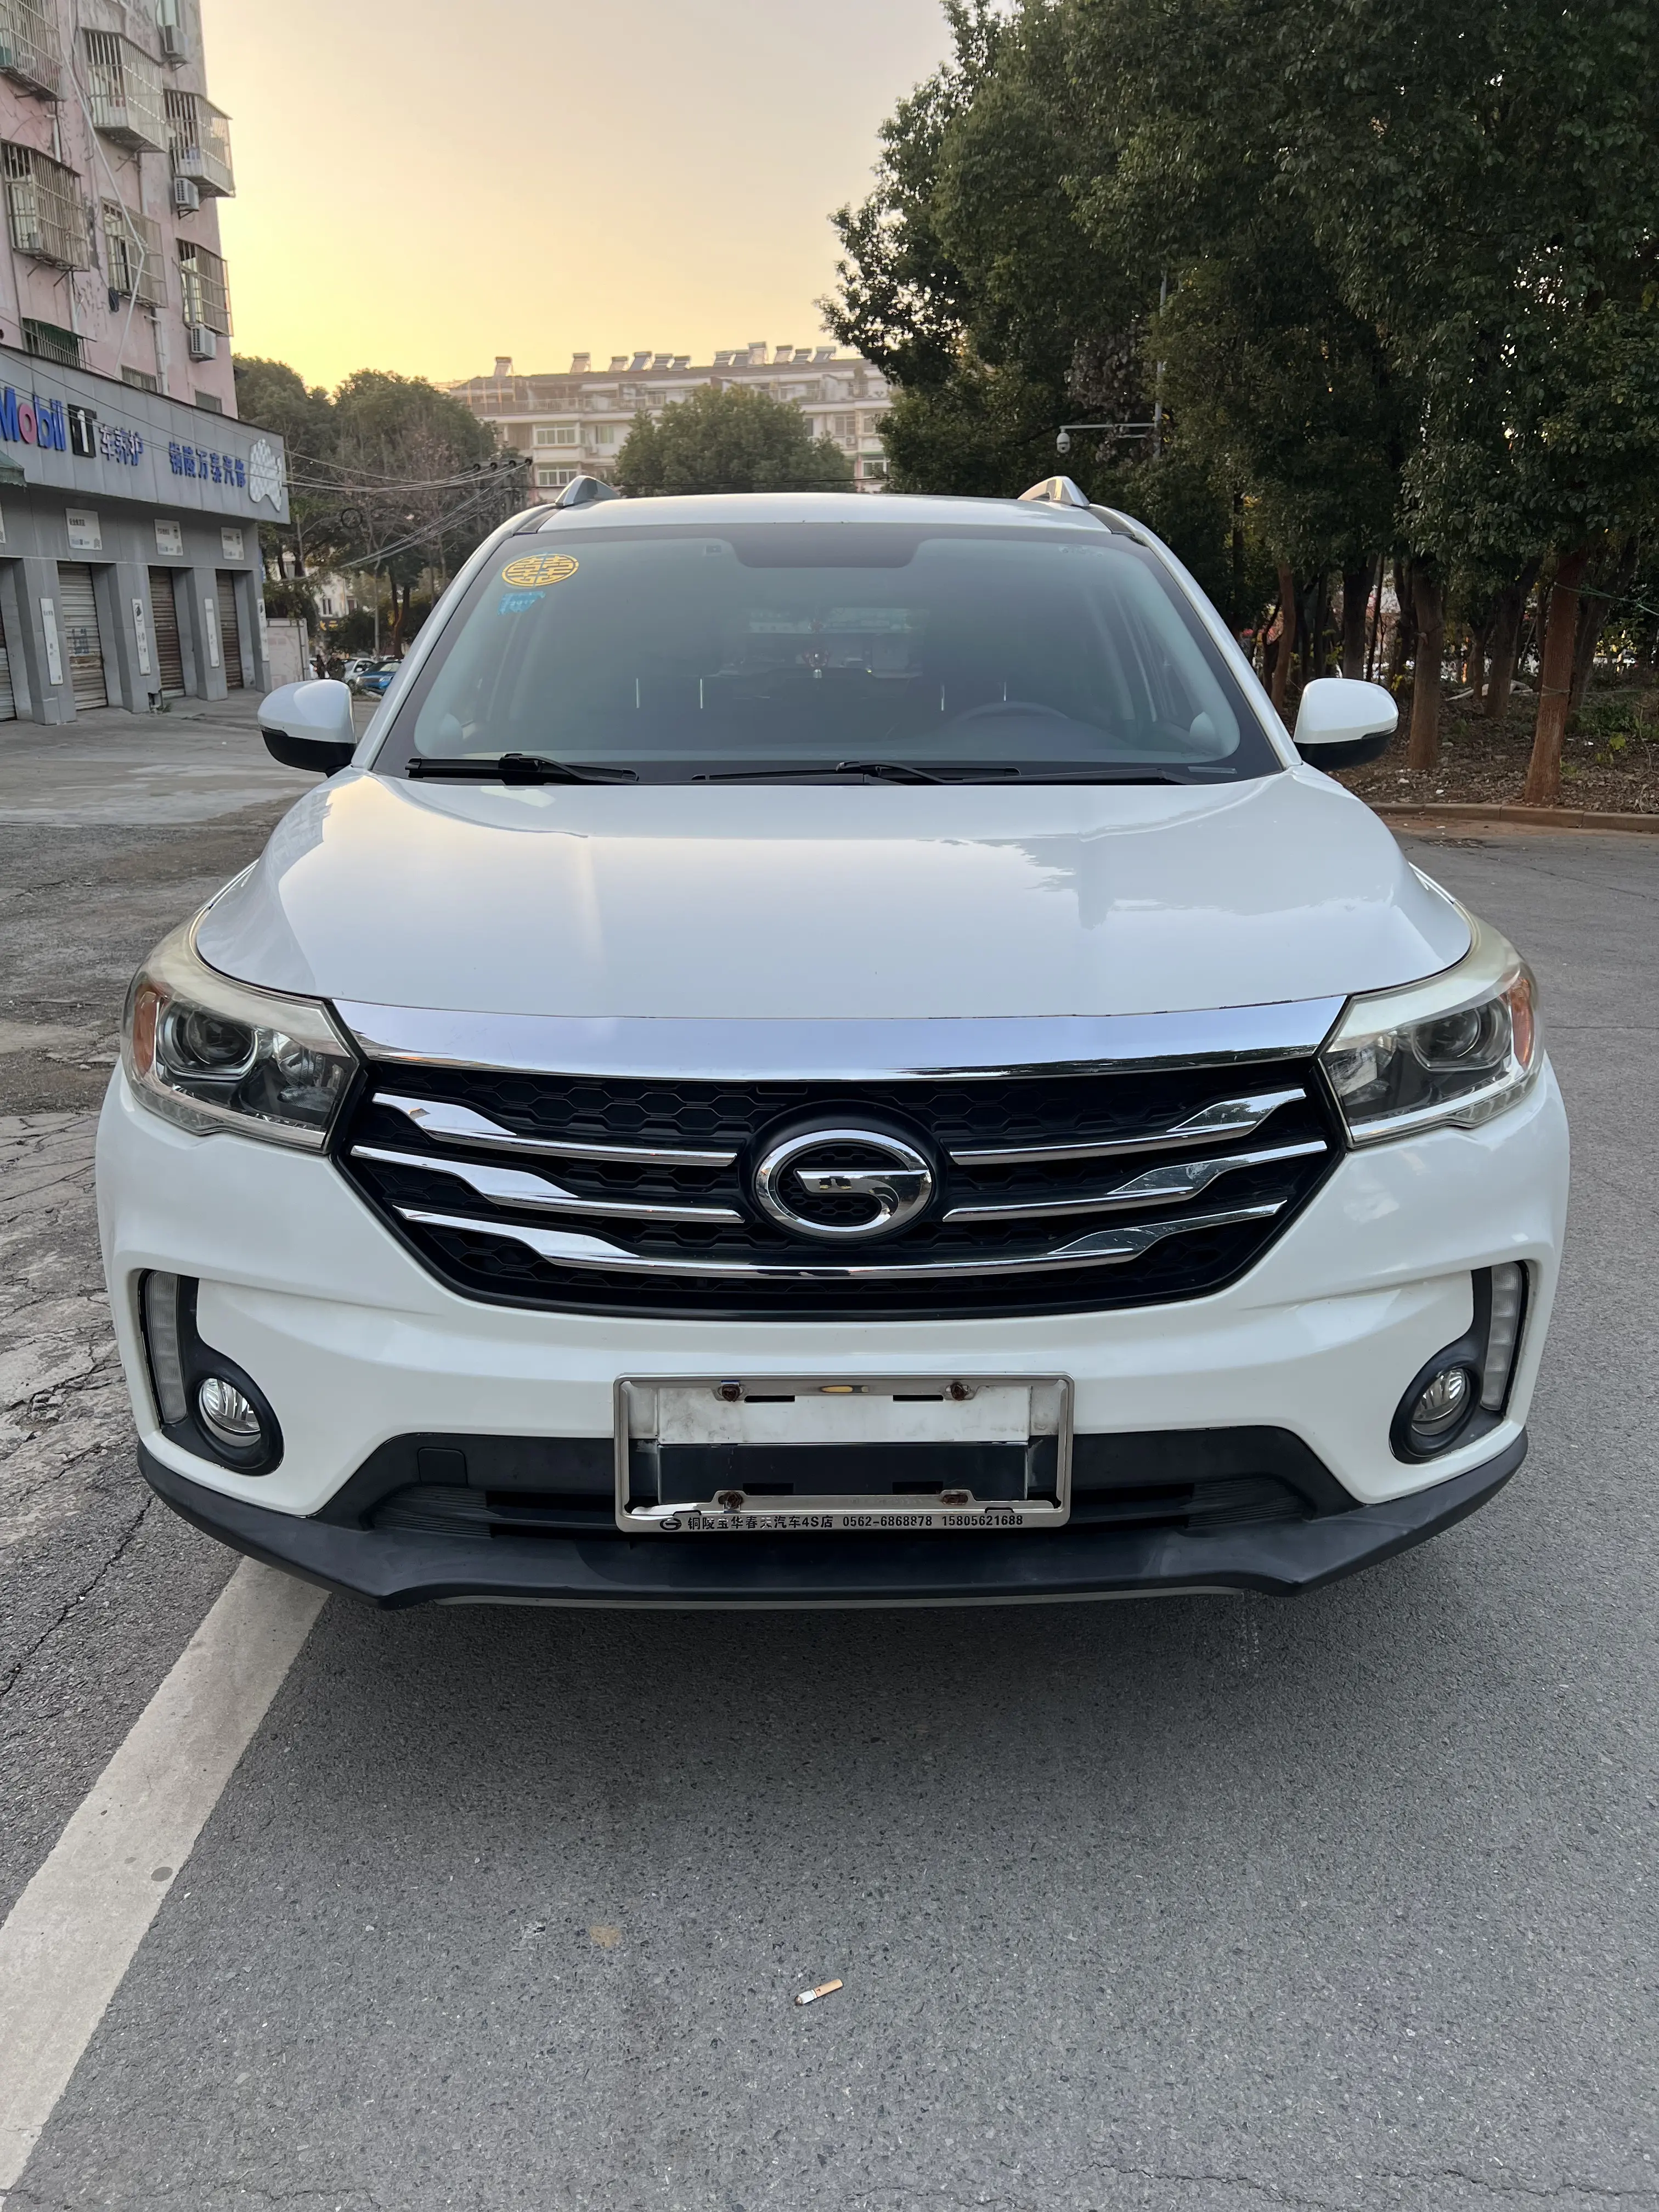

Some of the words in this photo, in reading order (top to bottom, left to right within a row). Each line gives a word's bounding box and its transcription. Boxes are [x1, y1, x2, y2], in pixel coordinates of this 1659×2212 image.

[0, 386, 66, 452] Mobil
[99, 425, 144, 466] 车养护
[843, 1515, 932, 1527] 0562-6868878
[942, 1515, 1023, 1527] 15805621688
